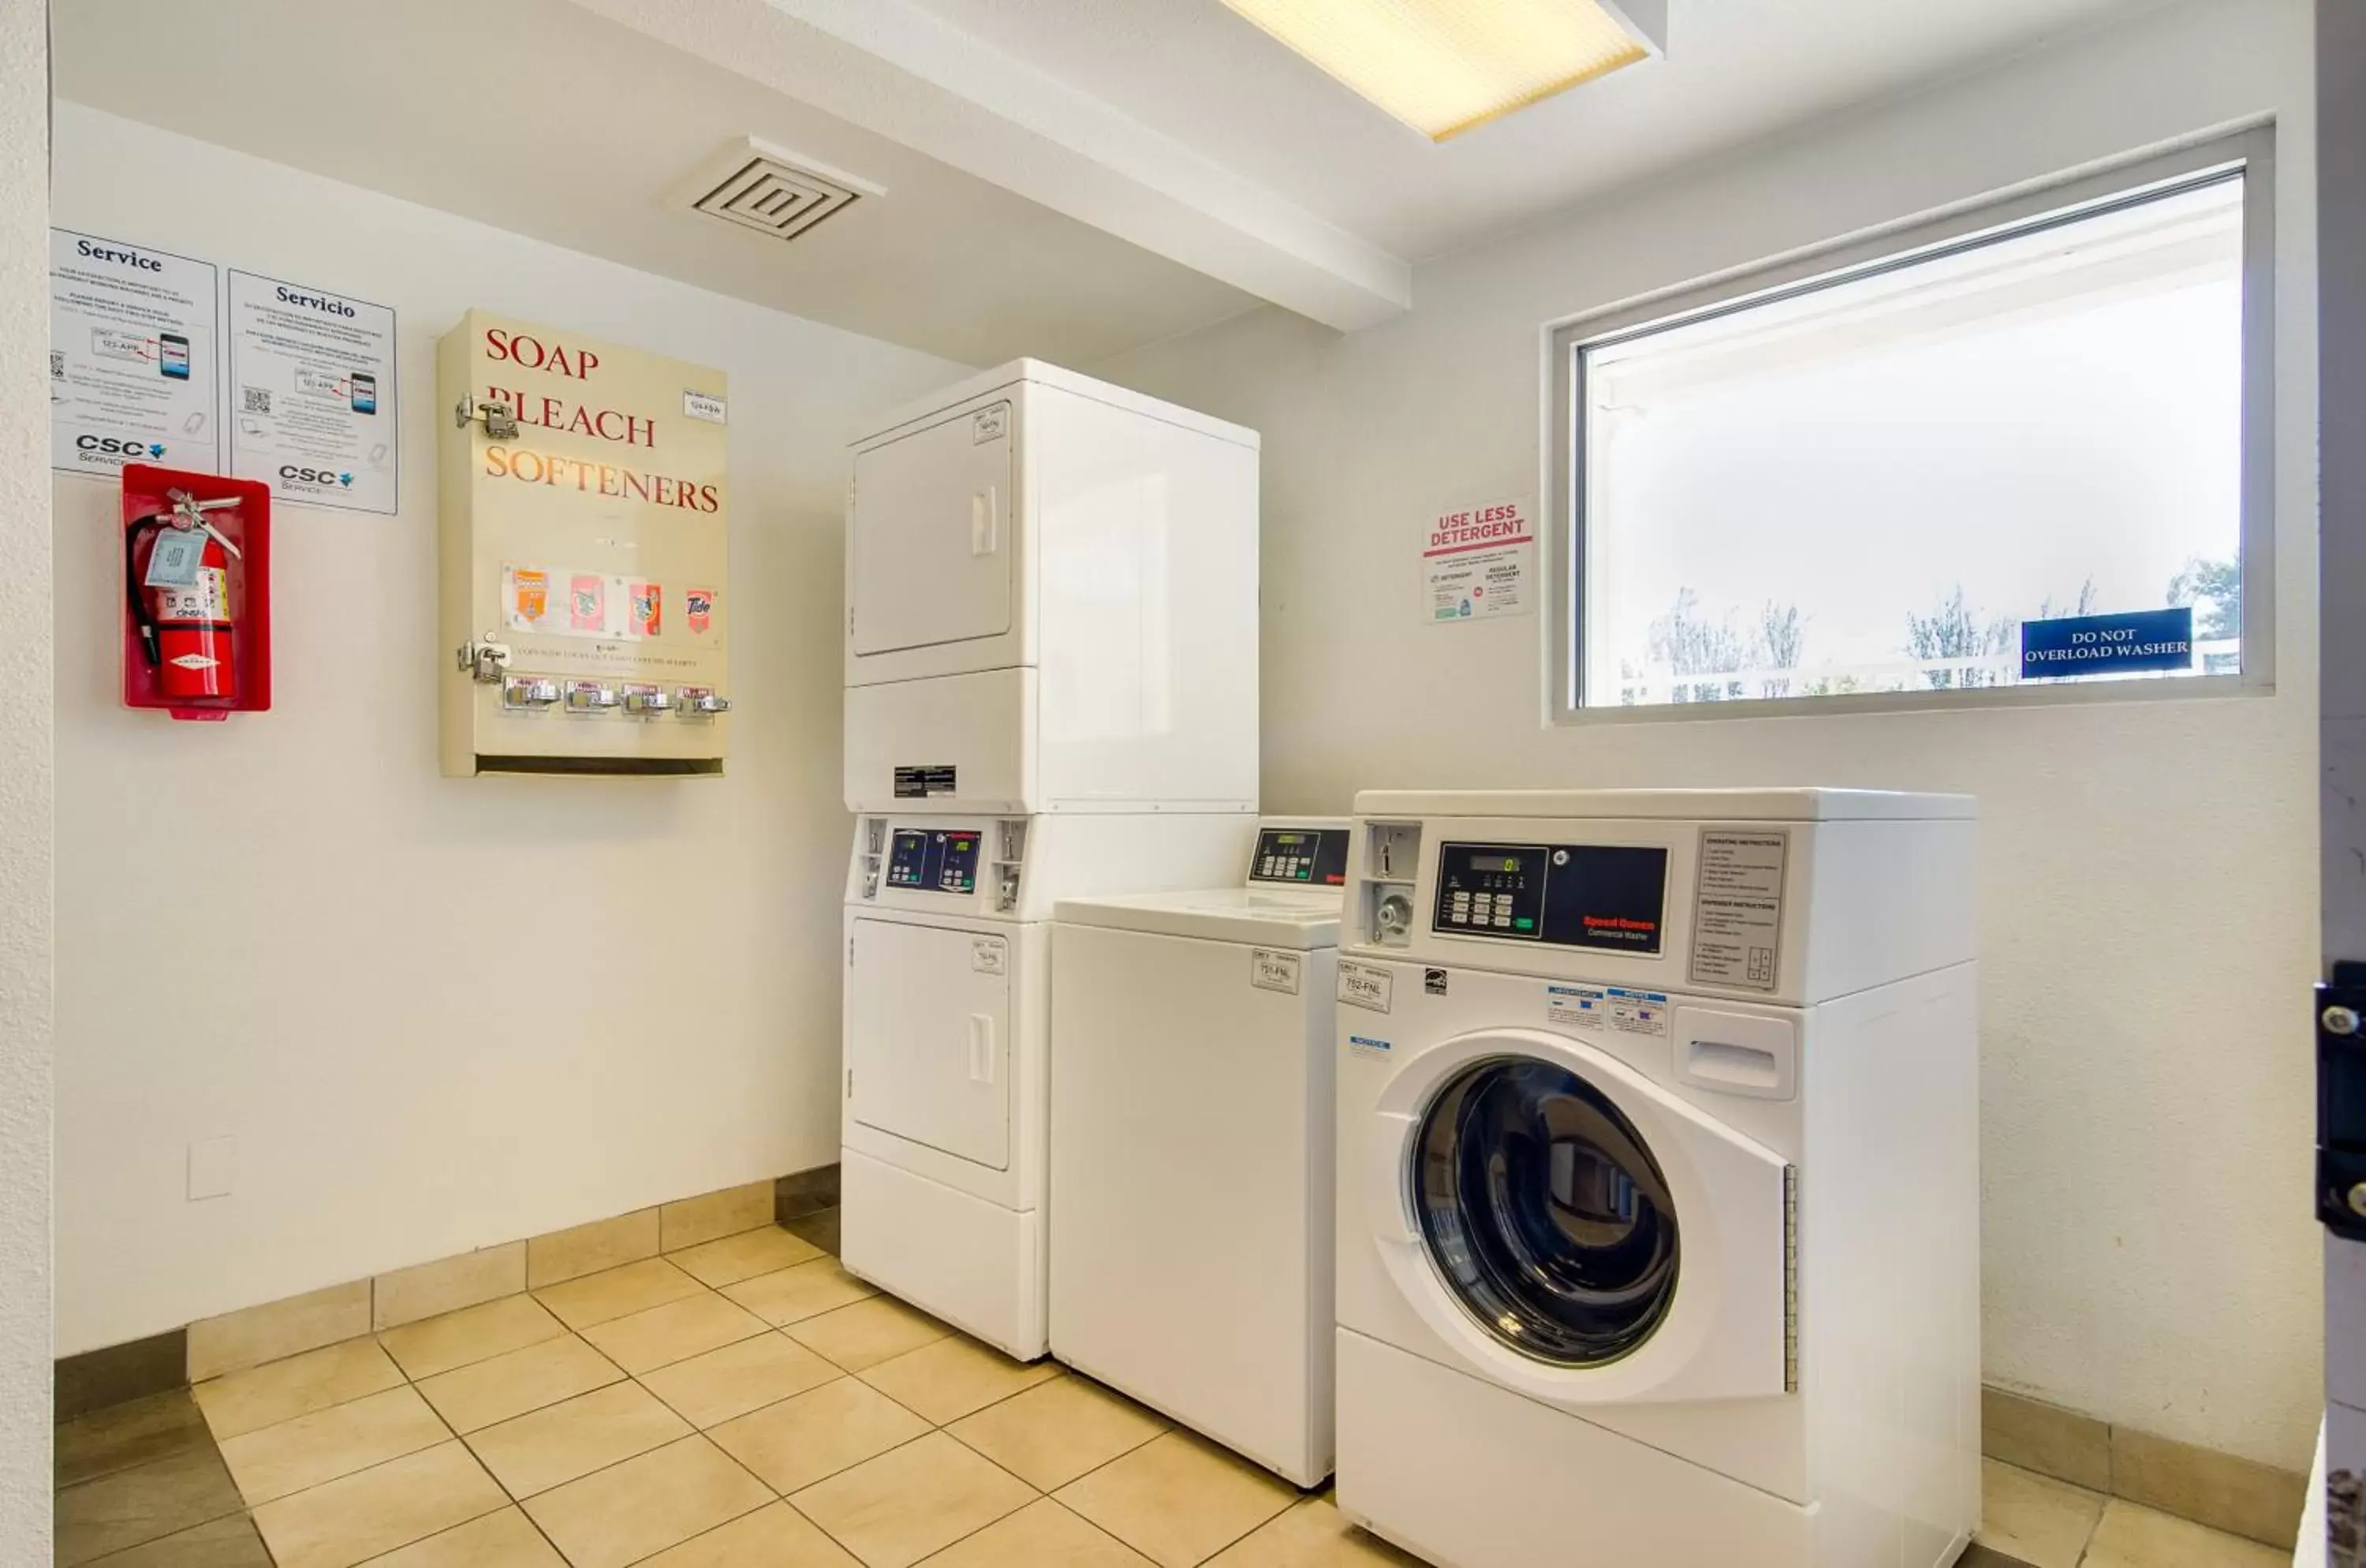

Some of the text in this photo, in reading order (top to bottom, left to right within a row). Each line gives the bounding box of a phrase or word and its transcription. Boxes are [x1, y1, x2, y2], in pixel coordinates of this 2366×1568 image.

[77, 240, 162, 272] Service
[277, 286, 355, 318] Servicio
[487, 328, 599, 381] SOAP
[77, 435, 144, 456] CSC
[278, 465, 336, 484] CSC
[485, 445, 718, 513] SOFTENERS
[1439, 505, 1516, 530] USE LESS
[1431, 519, 1524, 546] DETERGENT
[2072, 629, 2138, 644] DO NOT
[2025, 641, 2189, 663] OVERLOAD WASHER
